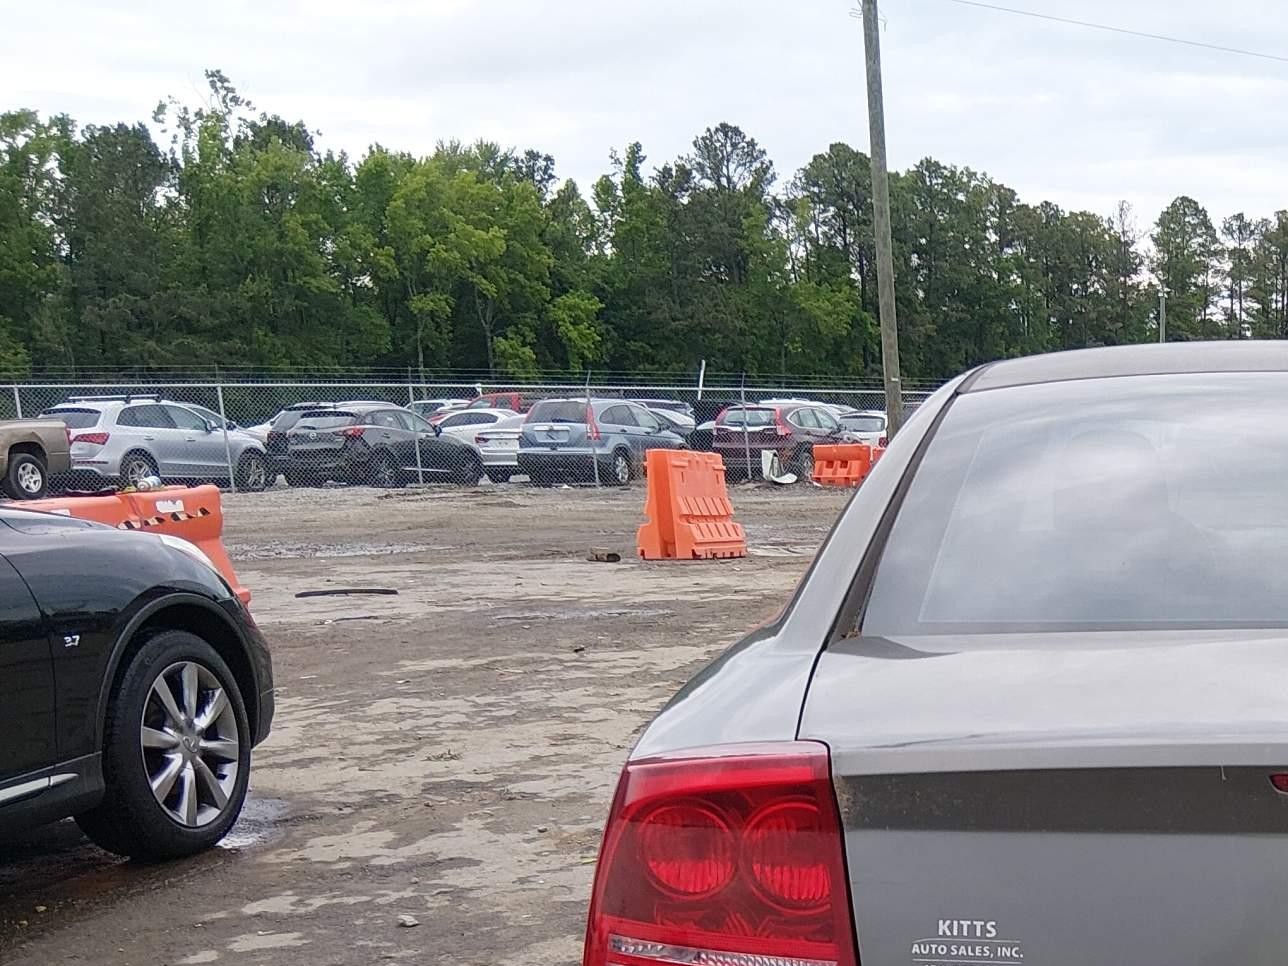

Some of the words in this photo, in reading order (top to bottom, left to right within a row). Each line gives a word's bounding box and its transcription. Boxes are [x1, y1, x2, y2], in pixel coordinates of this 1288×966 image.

[938, 919, 997, 937] KITTS
[912, 944, 947, 955] AUTO
[951, 945, 994, 958] SALES,
[997, 946, 1024, 958] INC.
